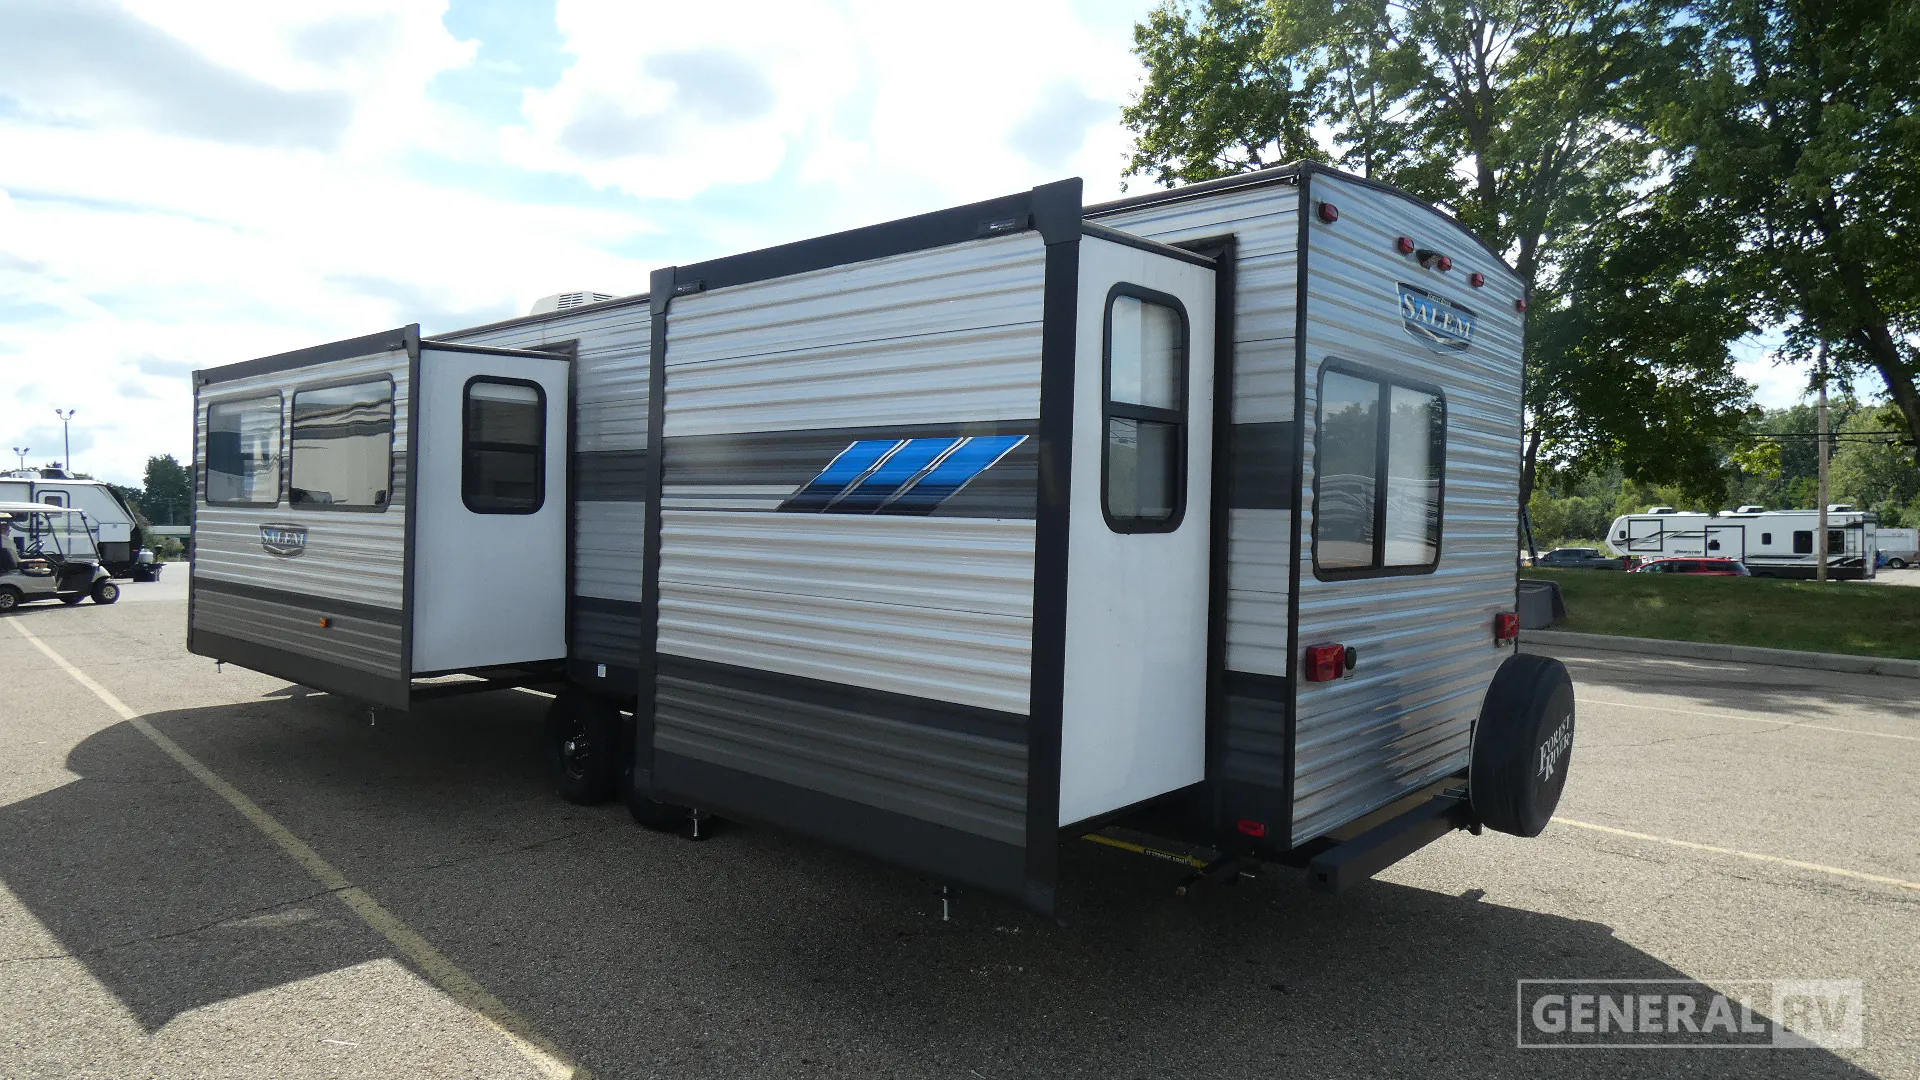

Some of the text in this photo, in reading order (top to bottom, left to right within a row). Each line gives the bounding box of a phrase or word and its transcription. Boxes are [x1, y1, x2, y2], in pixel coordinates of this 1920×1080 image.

[1403, 293, 1470, 338] SALEM
[262, 528, 304, 545] SALEM
[1537, 714, 1570, 776] FOREST
[1544, 732, 1571, 782] RIVER
